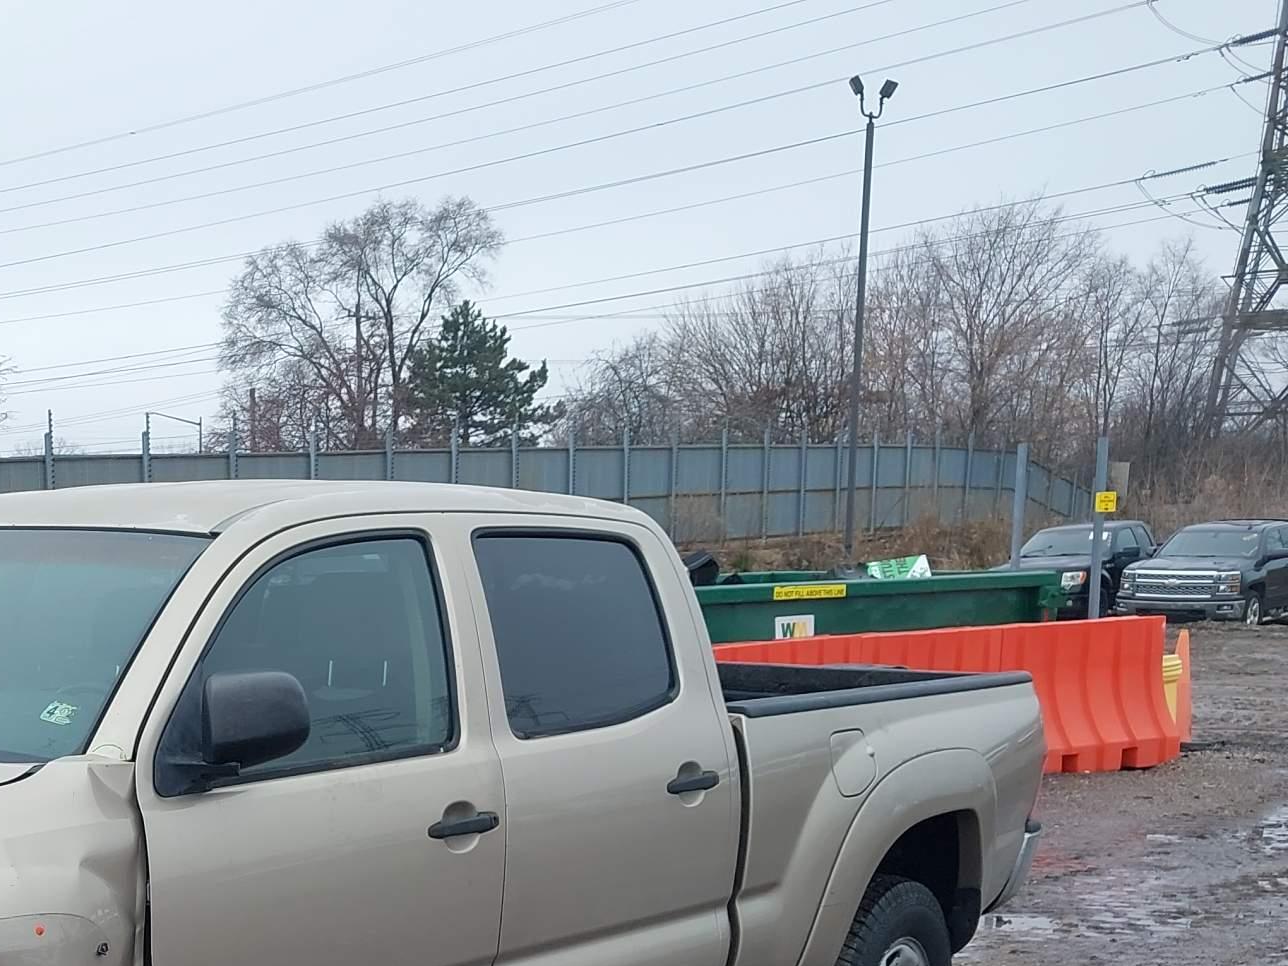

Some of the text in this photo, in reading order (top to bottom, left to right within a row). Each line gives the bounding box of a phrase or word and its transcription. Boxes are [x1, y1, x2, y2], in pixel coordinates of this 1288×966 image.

[806, 589, 821, 597] ABOVE
[834, 588, 844, 596] LINE
[781, 622, 808, 638] WM
